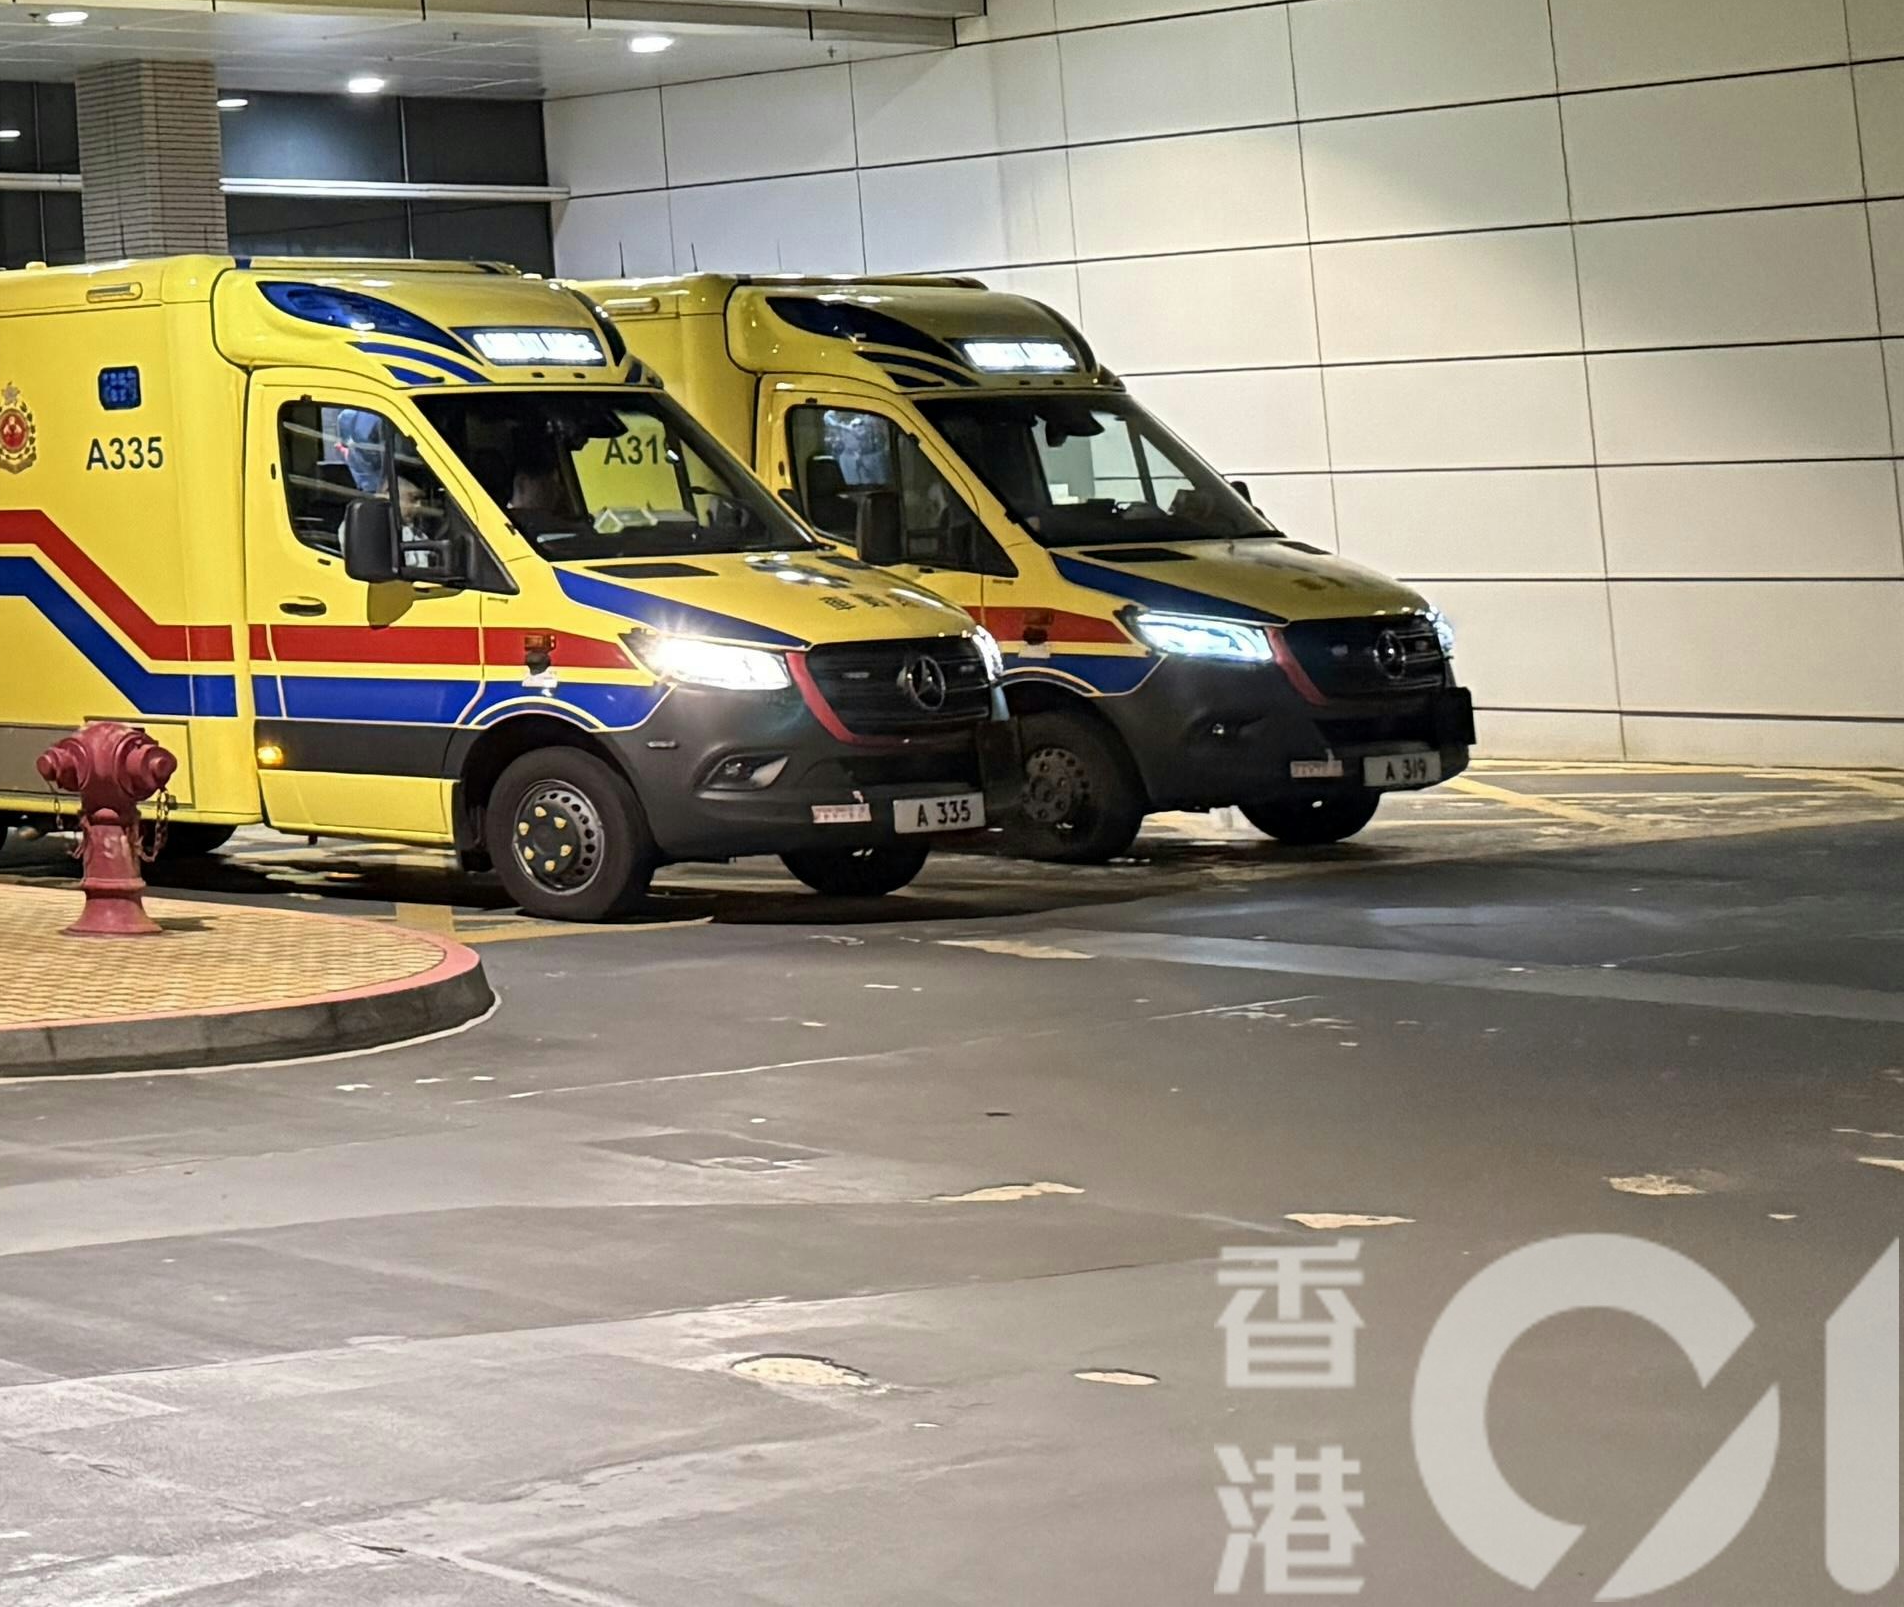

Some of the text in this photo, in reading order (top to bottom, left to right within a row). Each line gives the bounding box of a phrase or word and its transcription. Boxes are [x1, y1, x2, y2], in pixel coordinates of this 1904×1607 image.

[86, 436, 163, 471] A335
[1385, 758, 1427, 781] A 319
[917, 800, 972, 827] A 335
